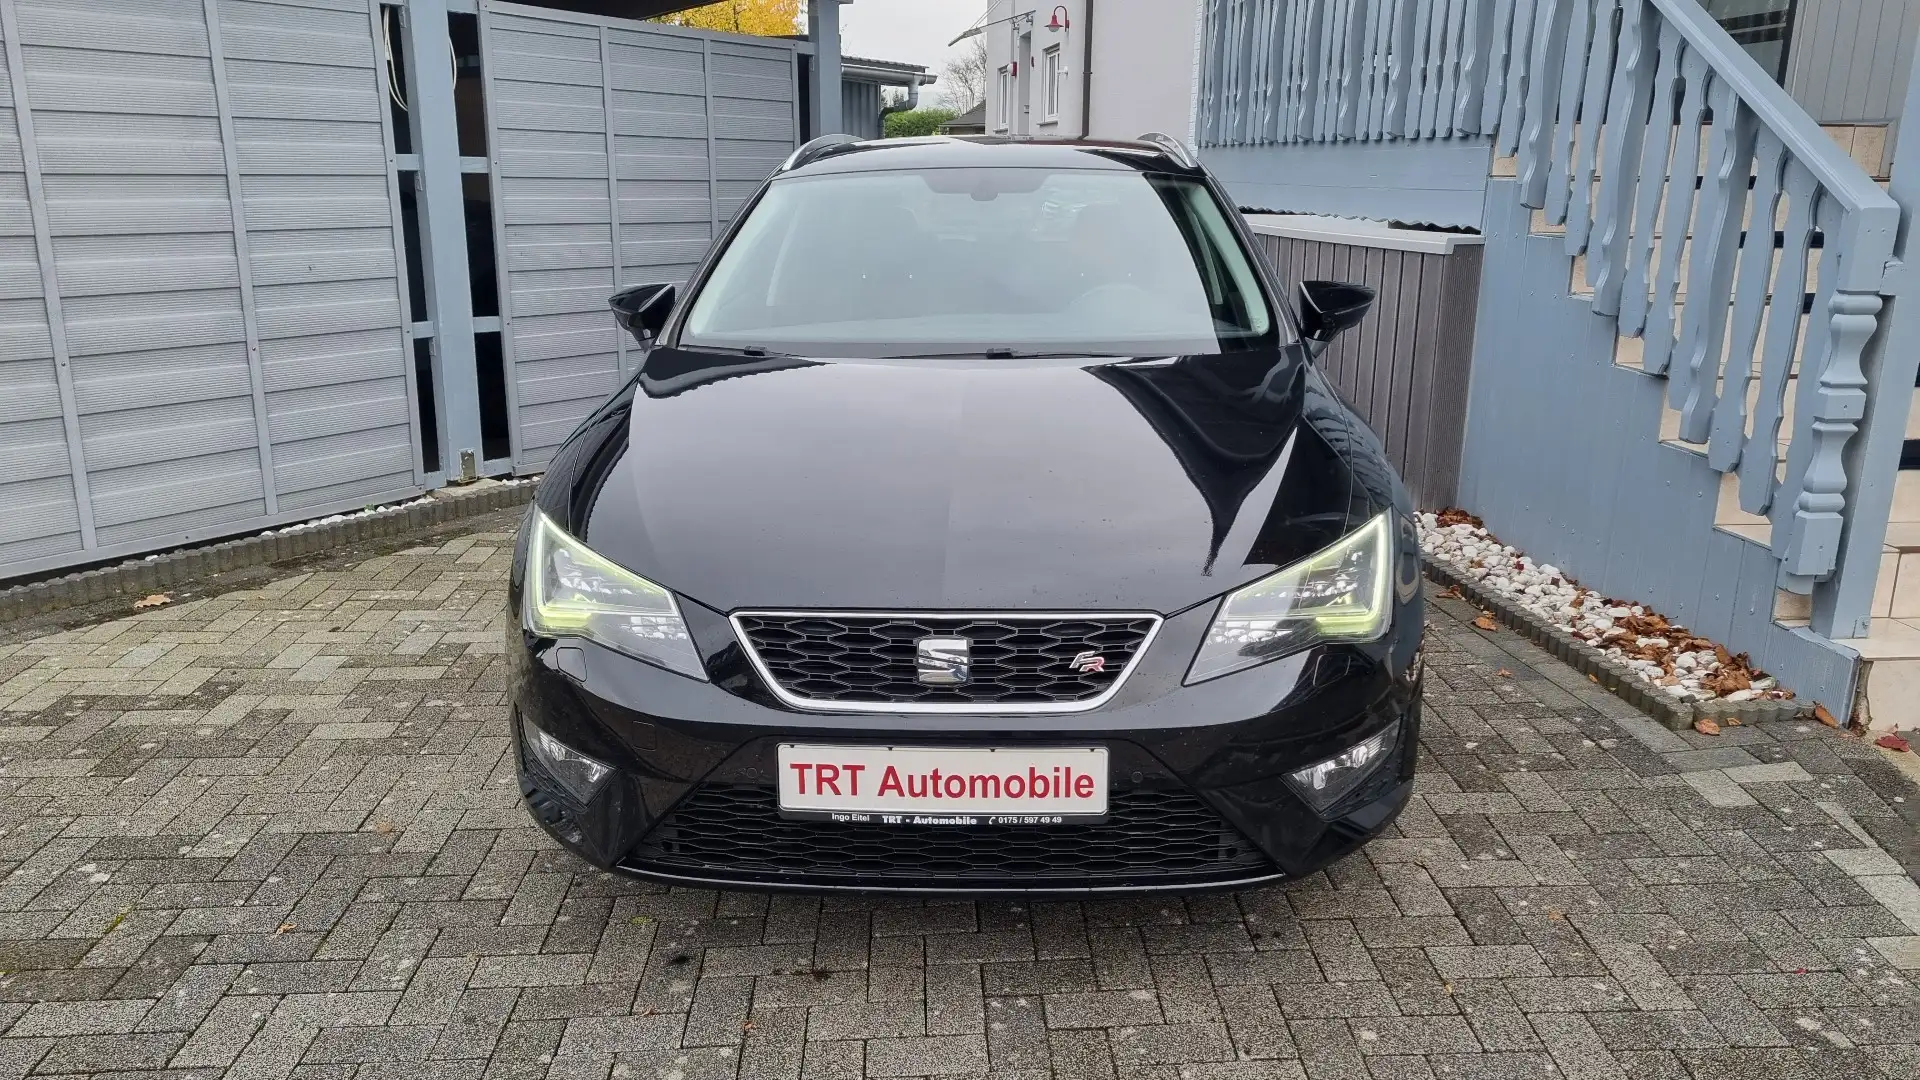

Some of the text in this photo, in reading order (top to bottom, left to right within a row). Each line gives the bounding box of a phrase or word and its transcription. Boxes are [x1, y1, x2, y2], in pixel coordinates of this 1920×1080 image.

[790, 763, 1094, 798] TRT Automobile
[831, 812, 870, 822] Ingo Eitel
[882, 815, 902, 824] TRT
[912, 815, 977, 825] Automobile
[998, 816, 1018, 824] 0175
[1023, 816, 1039, 824] 597
[1040, 816, 1051, 824] 49
[1051, 816, 1063, 824] 49
